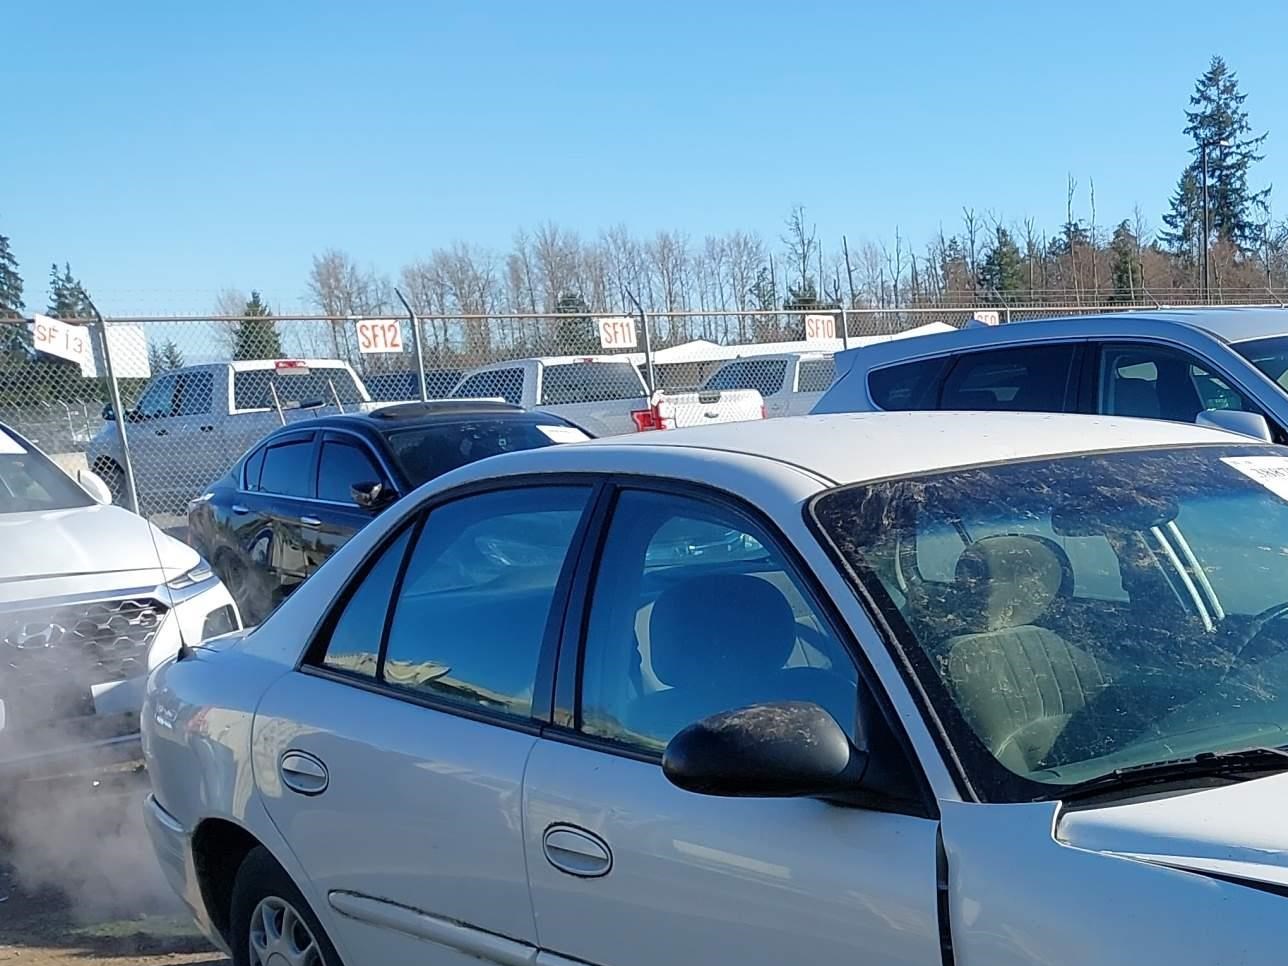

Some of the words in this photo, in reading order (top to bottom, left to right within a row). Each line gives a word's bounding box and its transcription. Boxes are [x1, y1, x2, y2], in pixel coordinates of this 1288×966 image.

[360, 324, 400, 348] SF12
[602, 322, 632, 344] SF11
[807, 318, 834, 338] SF10
